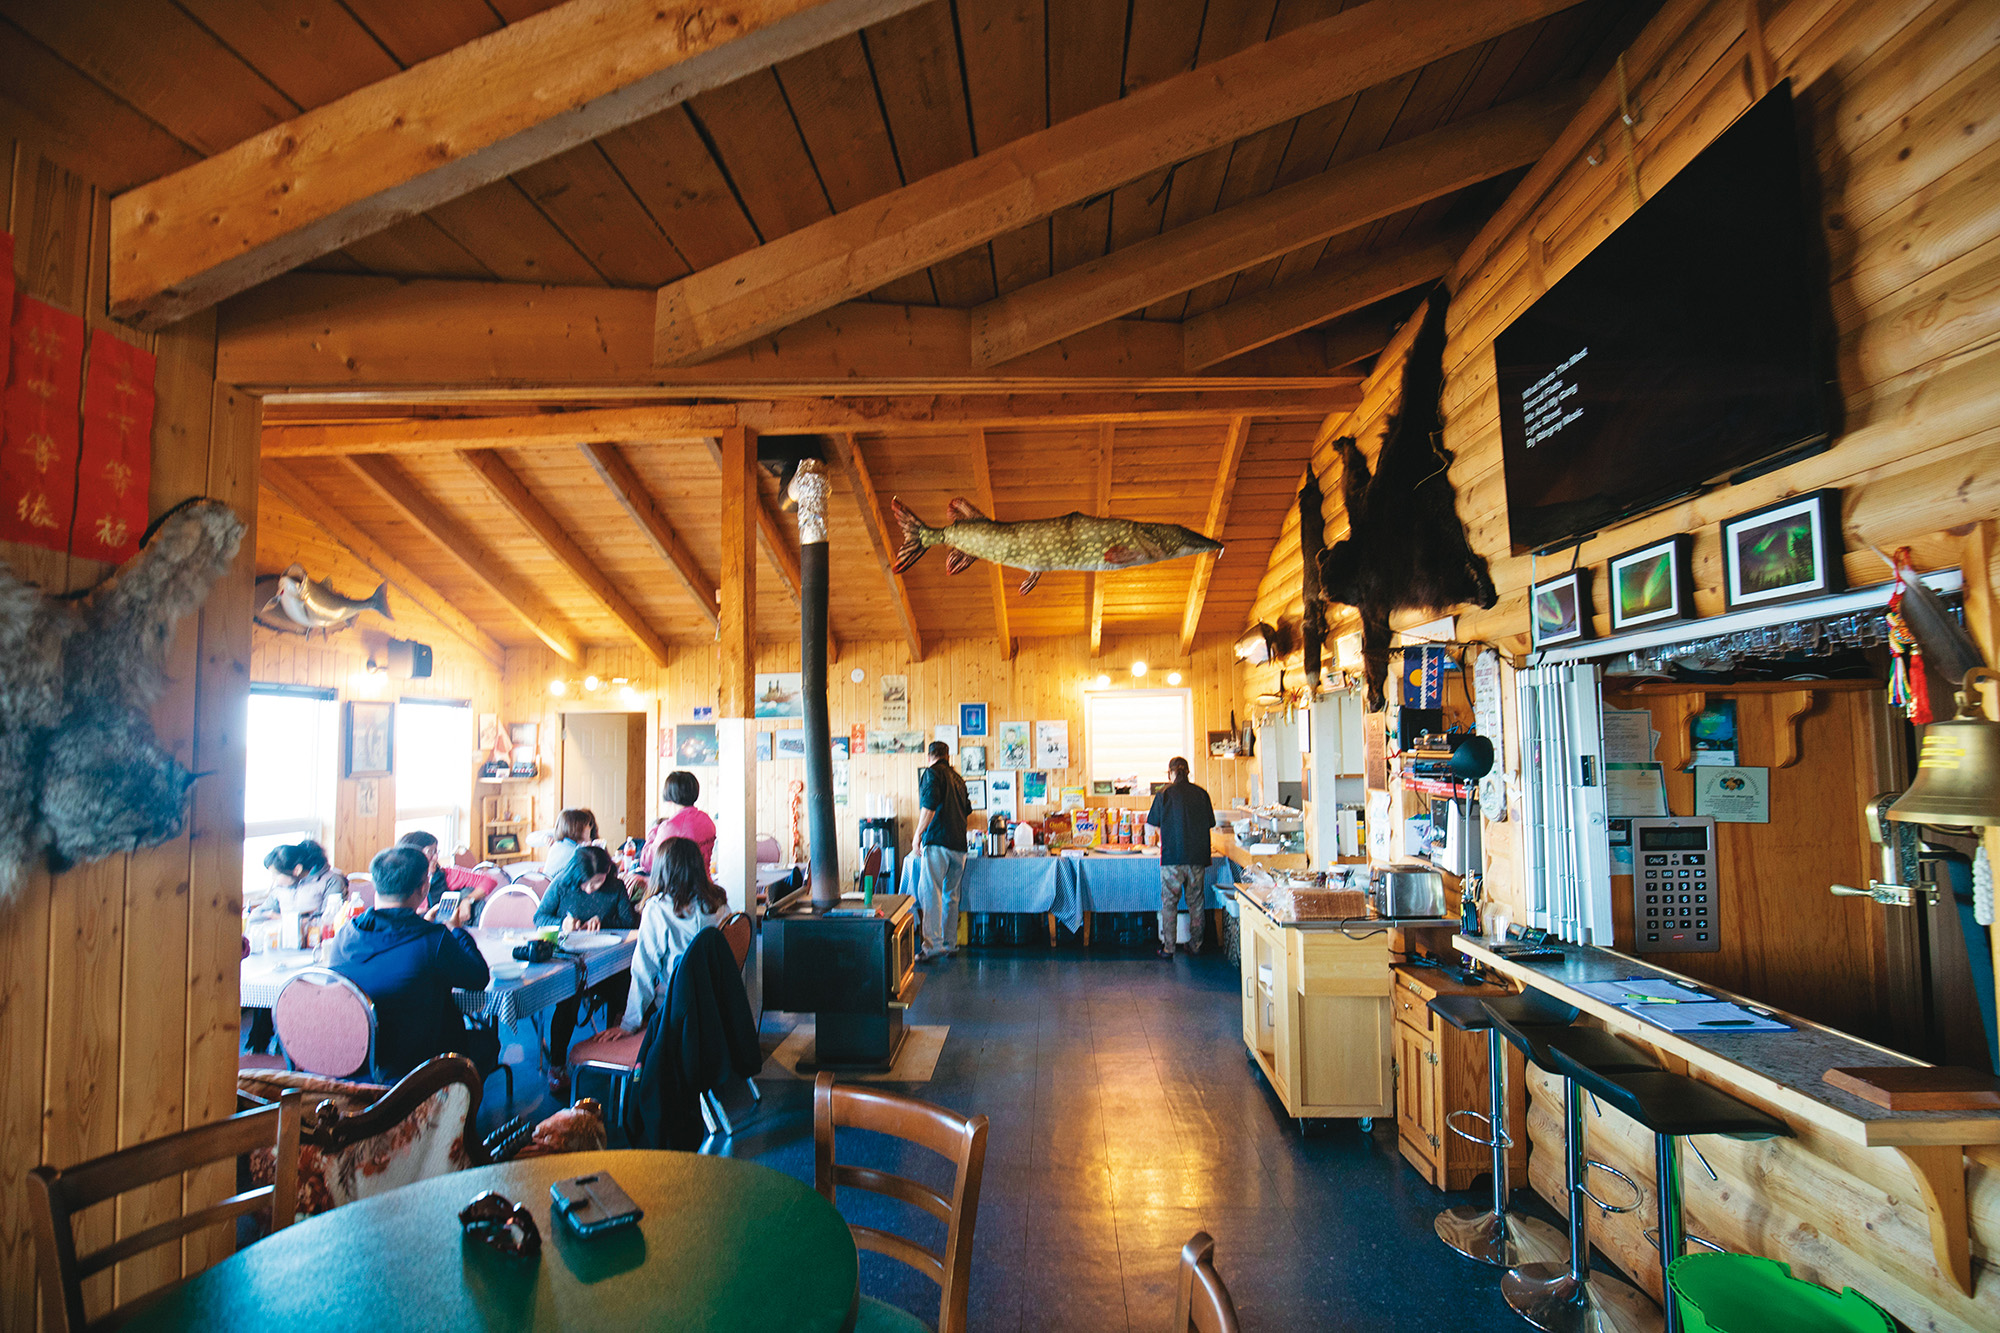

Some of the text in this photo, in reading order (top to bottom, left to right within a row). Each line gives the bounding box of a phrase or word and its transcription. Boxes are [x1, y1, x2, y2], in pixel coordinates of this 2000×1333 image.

[1665, 883, 1672, 891] 8
[1666, 895, 1672, 903] 5
[1682, 895, 1688, 903] 6
[1667, 908, 1672, 916] 2
[1682, 908, 1689, 916] 3
